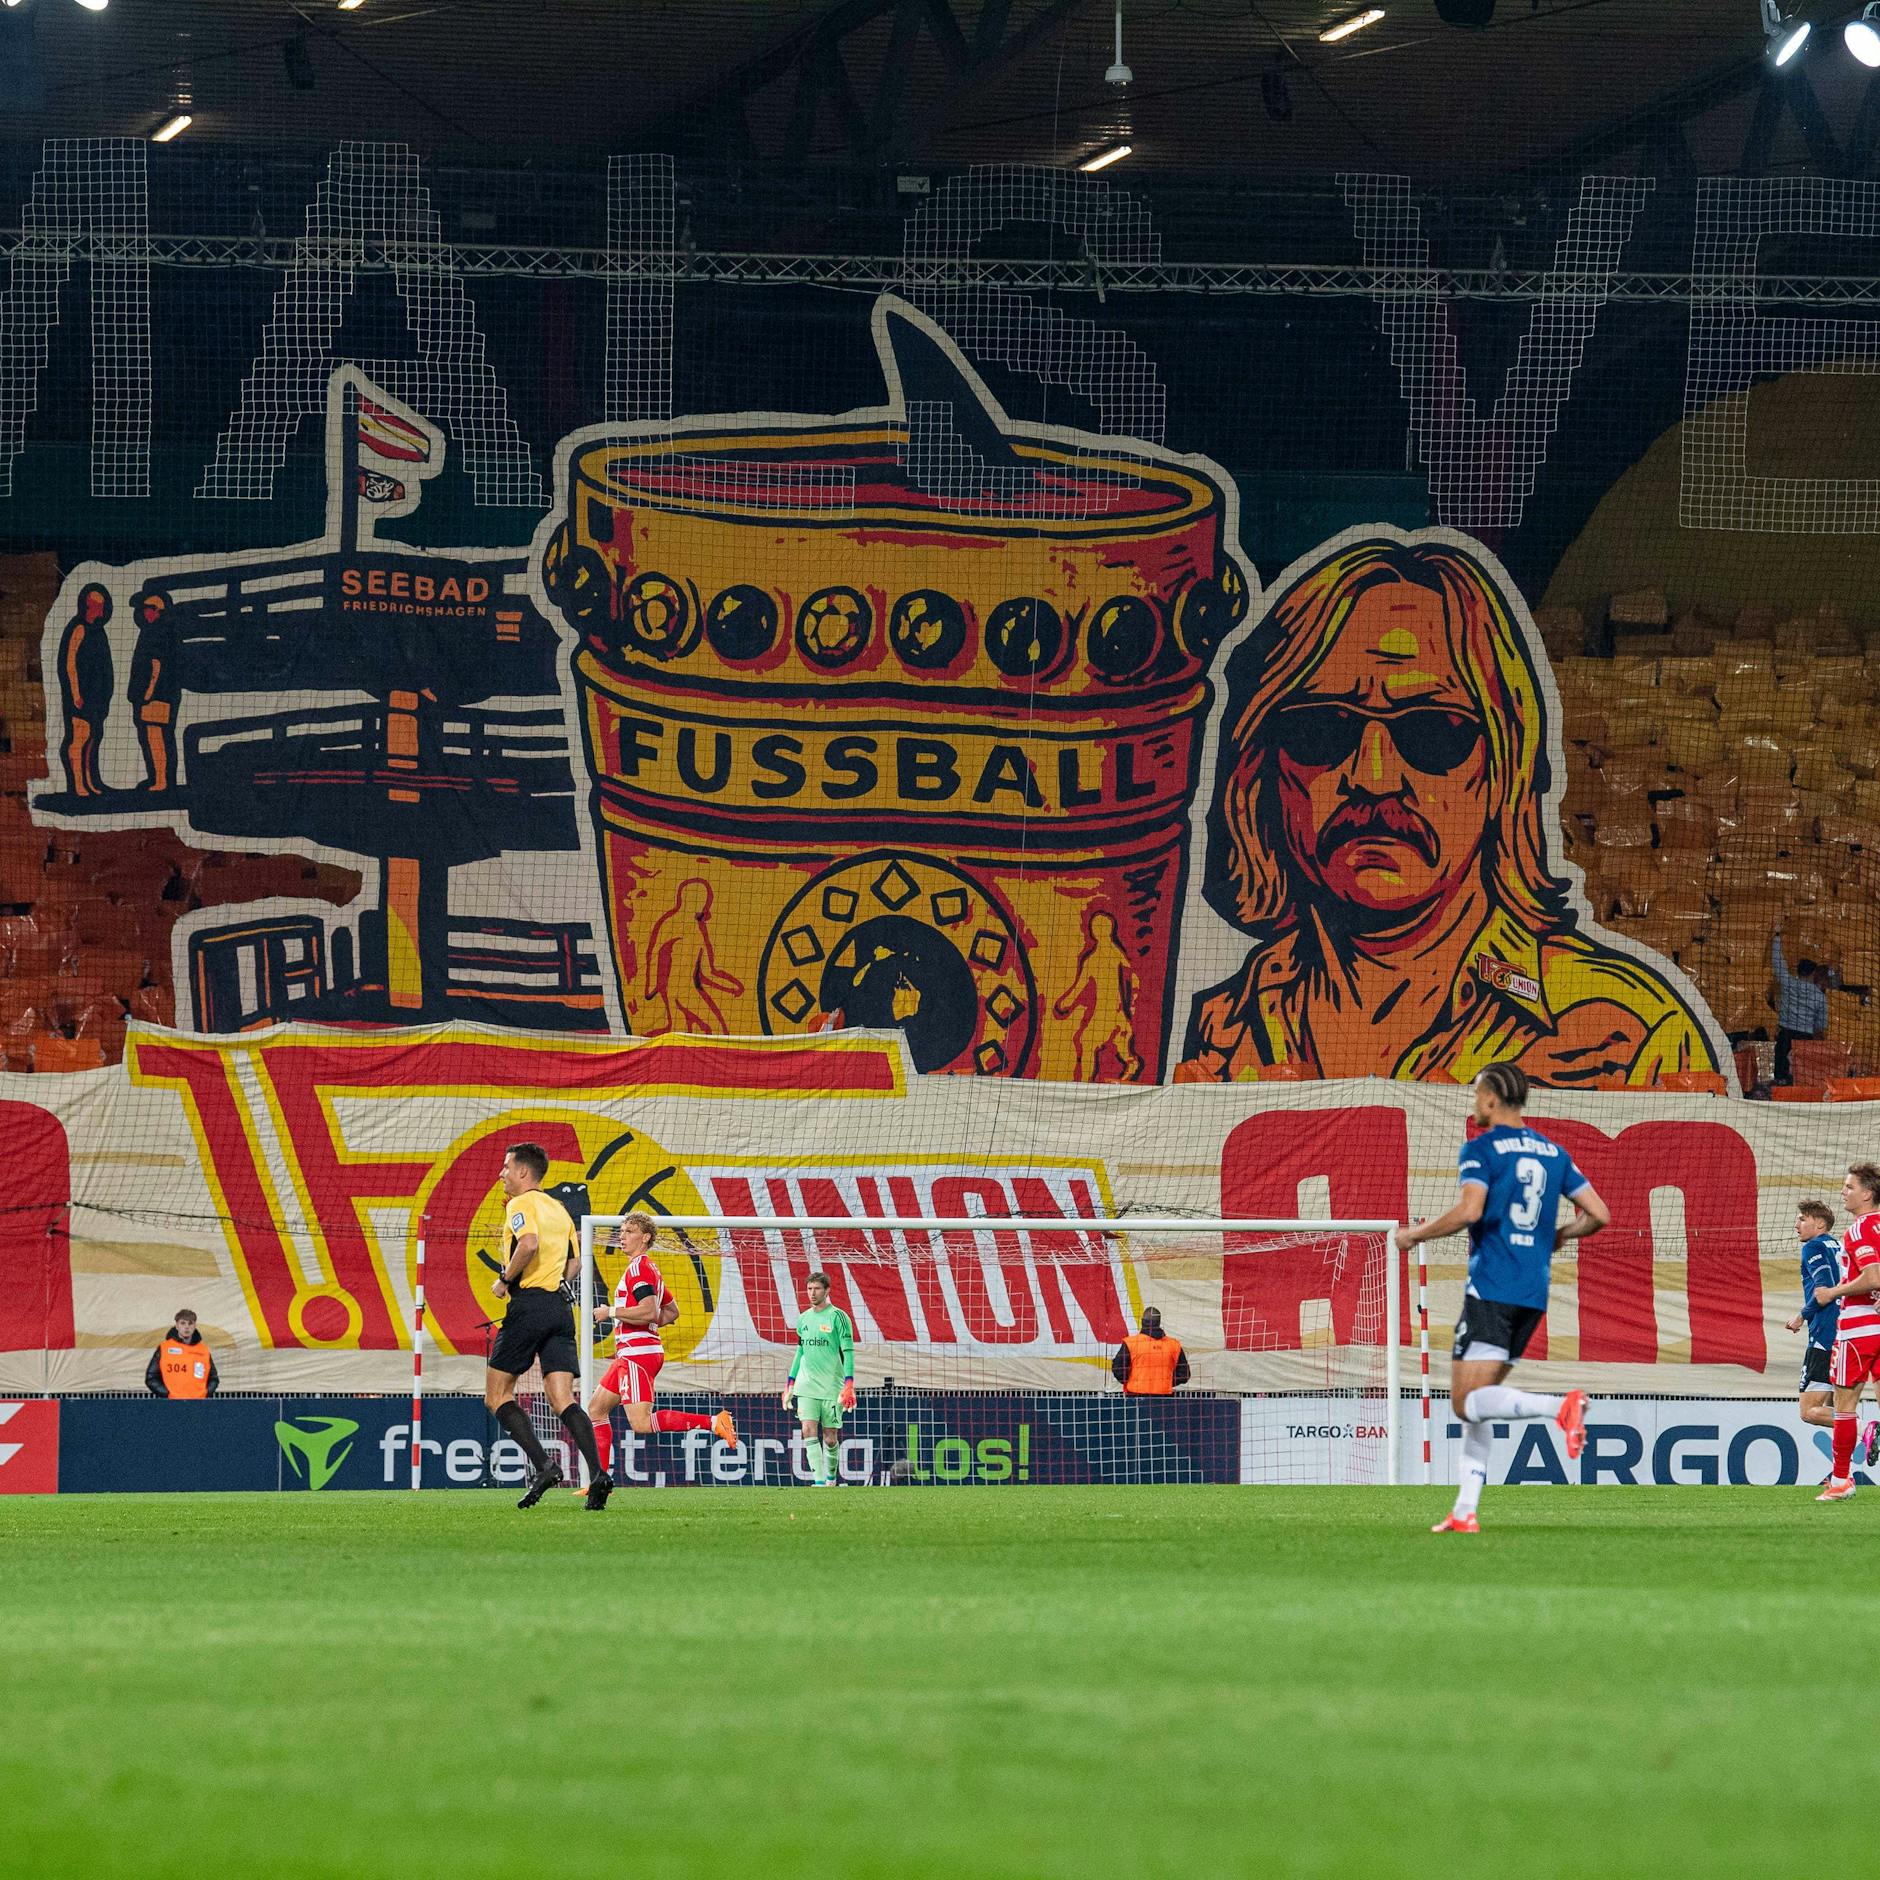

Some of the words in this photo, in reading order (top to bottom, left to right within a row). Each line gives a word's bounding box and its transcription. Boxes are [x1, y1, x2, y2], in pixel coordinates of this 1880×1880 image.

[342, 569, 489, 602] SEEBAD
[343, 601, 486, 616] FRIEDRICHSHAGEN
[619, 716, 1156, 808] FUSSBALL
[1509, 1157, 1548, 1231] 3
[709, 1175, 1137, 1346] UNION
[805, 1337, 829, 1347] raisin
[167, 1363, 187, 1373] 304
[1356, 1426, 1388, 1438] BAN
[907, 1424, 1029, 1480] los!
